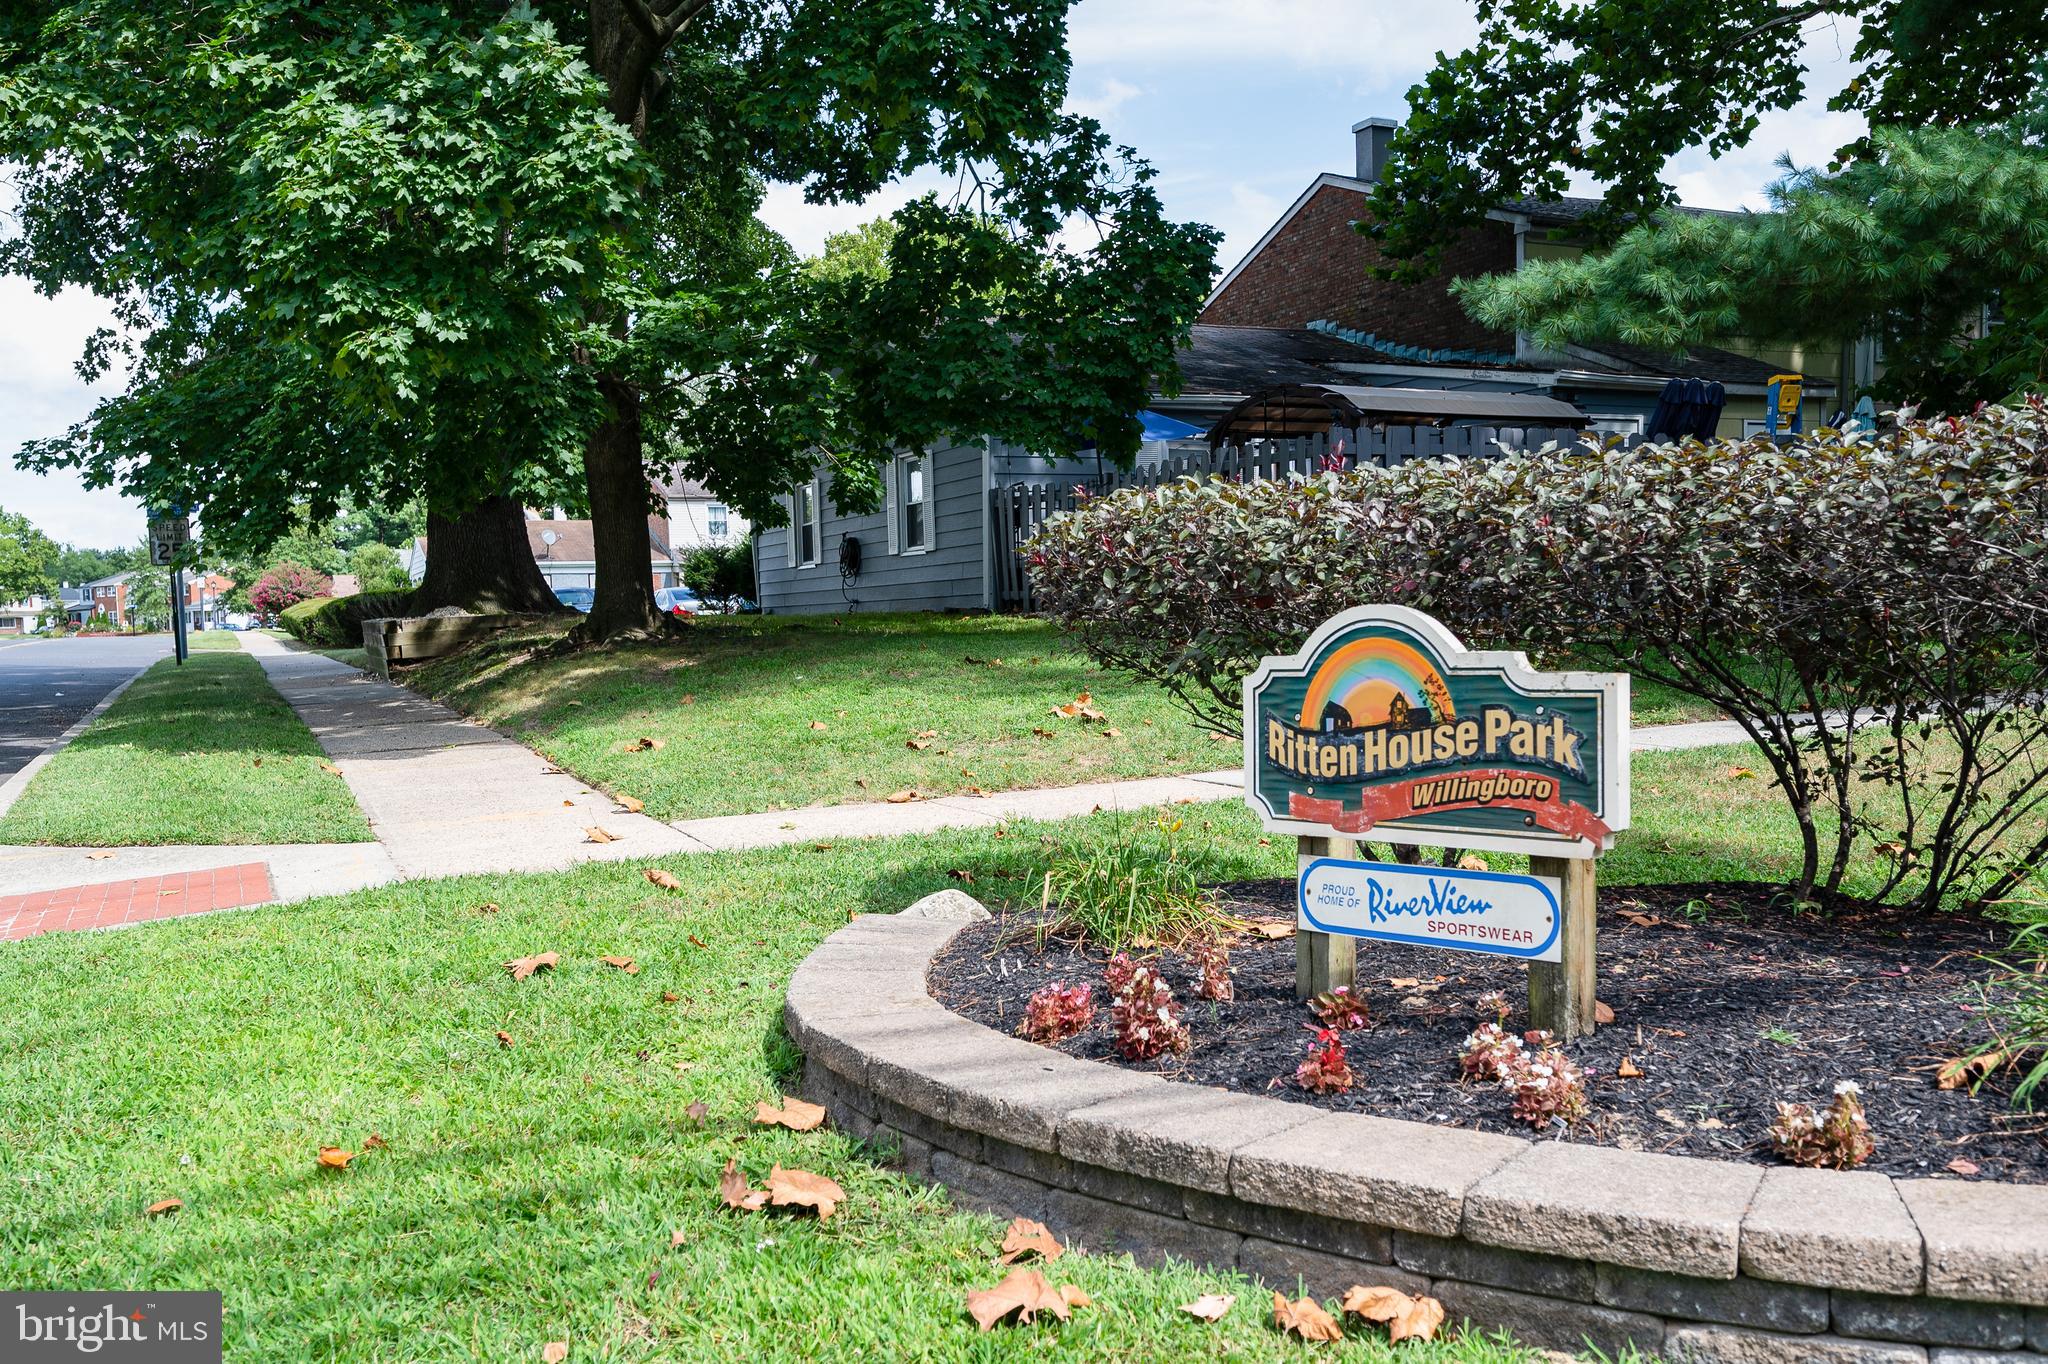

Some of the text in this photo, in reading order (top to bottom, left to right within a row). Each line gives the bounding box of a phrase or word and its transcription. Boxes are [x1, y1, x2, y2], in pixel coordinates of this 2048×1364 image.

[151, 523, 186, 531] SPEED
[156, 533, 183, 541] LIMIT
[1268, 708, 1578, 778] Ritten House Park
[1412, 774, 1553, 809] Willingboro
[1322, 883, 1356, 897] PROUD
[1317, 896, 1361, 908] HOME OF
[1366, 877, 1493, 924] RiverView
[1427, 920, 1534, 944] SPORTSWEAR
